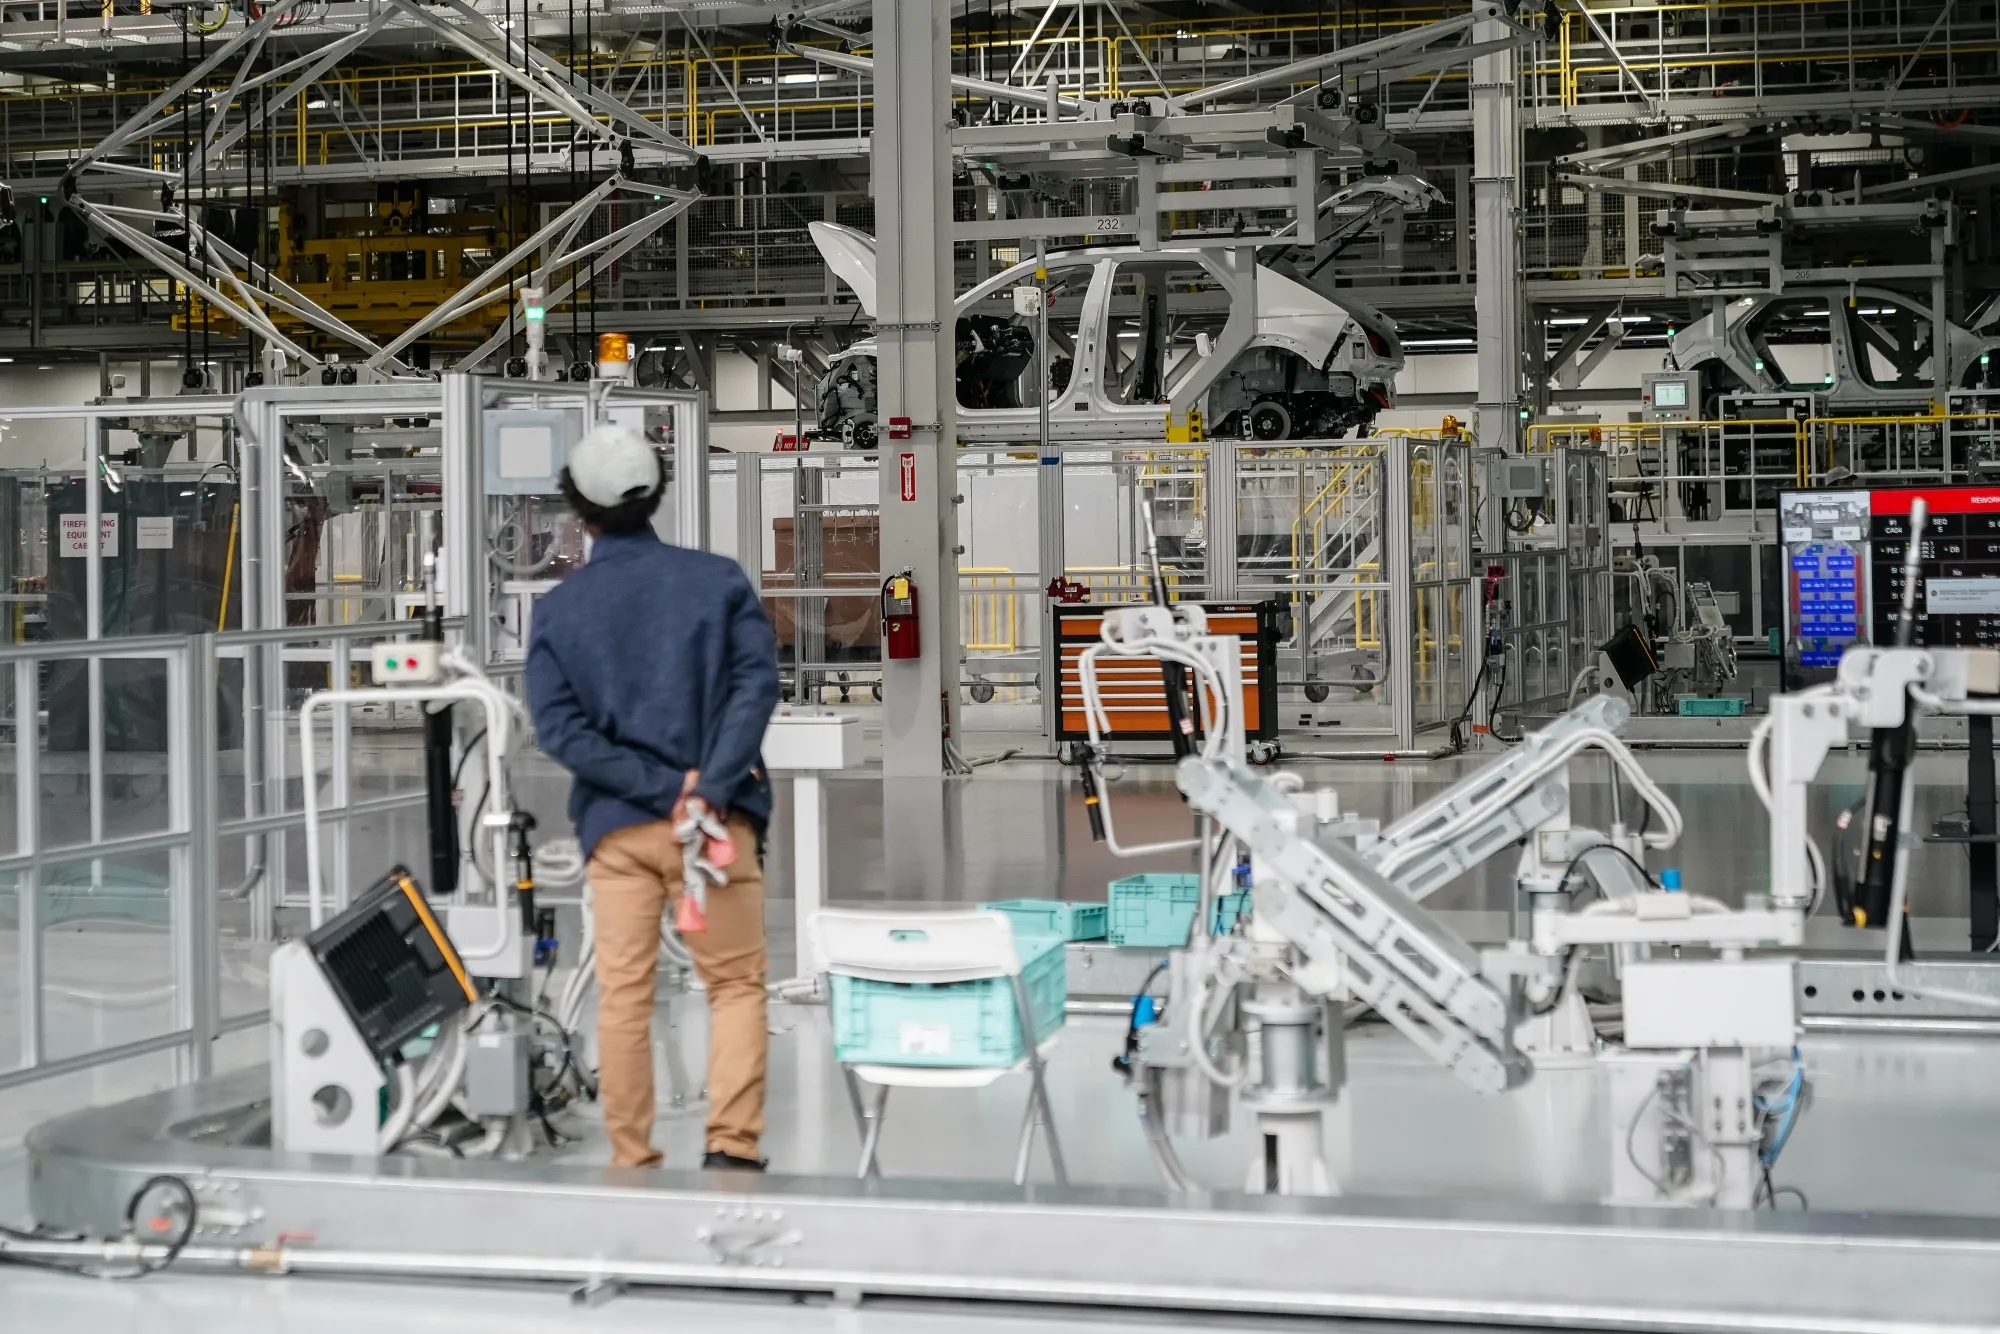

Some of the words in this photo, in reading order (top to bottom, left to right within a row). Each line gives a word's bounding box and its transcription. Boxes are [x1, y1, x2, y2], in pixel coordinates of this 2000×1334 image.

[1097, 218, 1119, 230] 232
[1795, 271, 1811, 279] 205
[62, 520, 115, 528] FIREFIING
[66, 530, 112, 539] EQUINT
[72, 542, 105, 550] CABT
